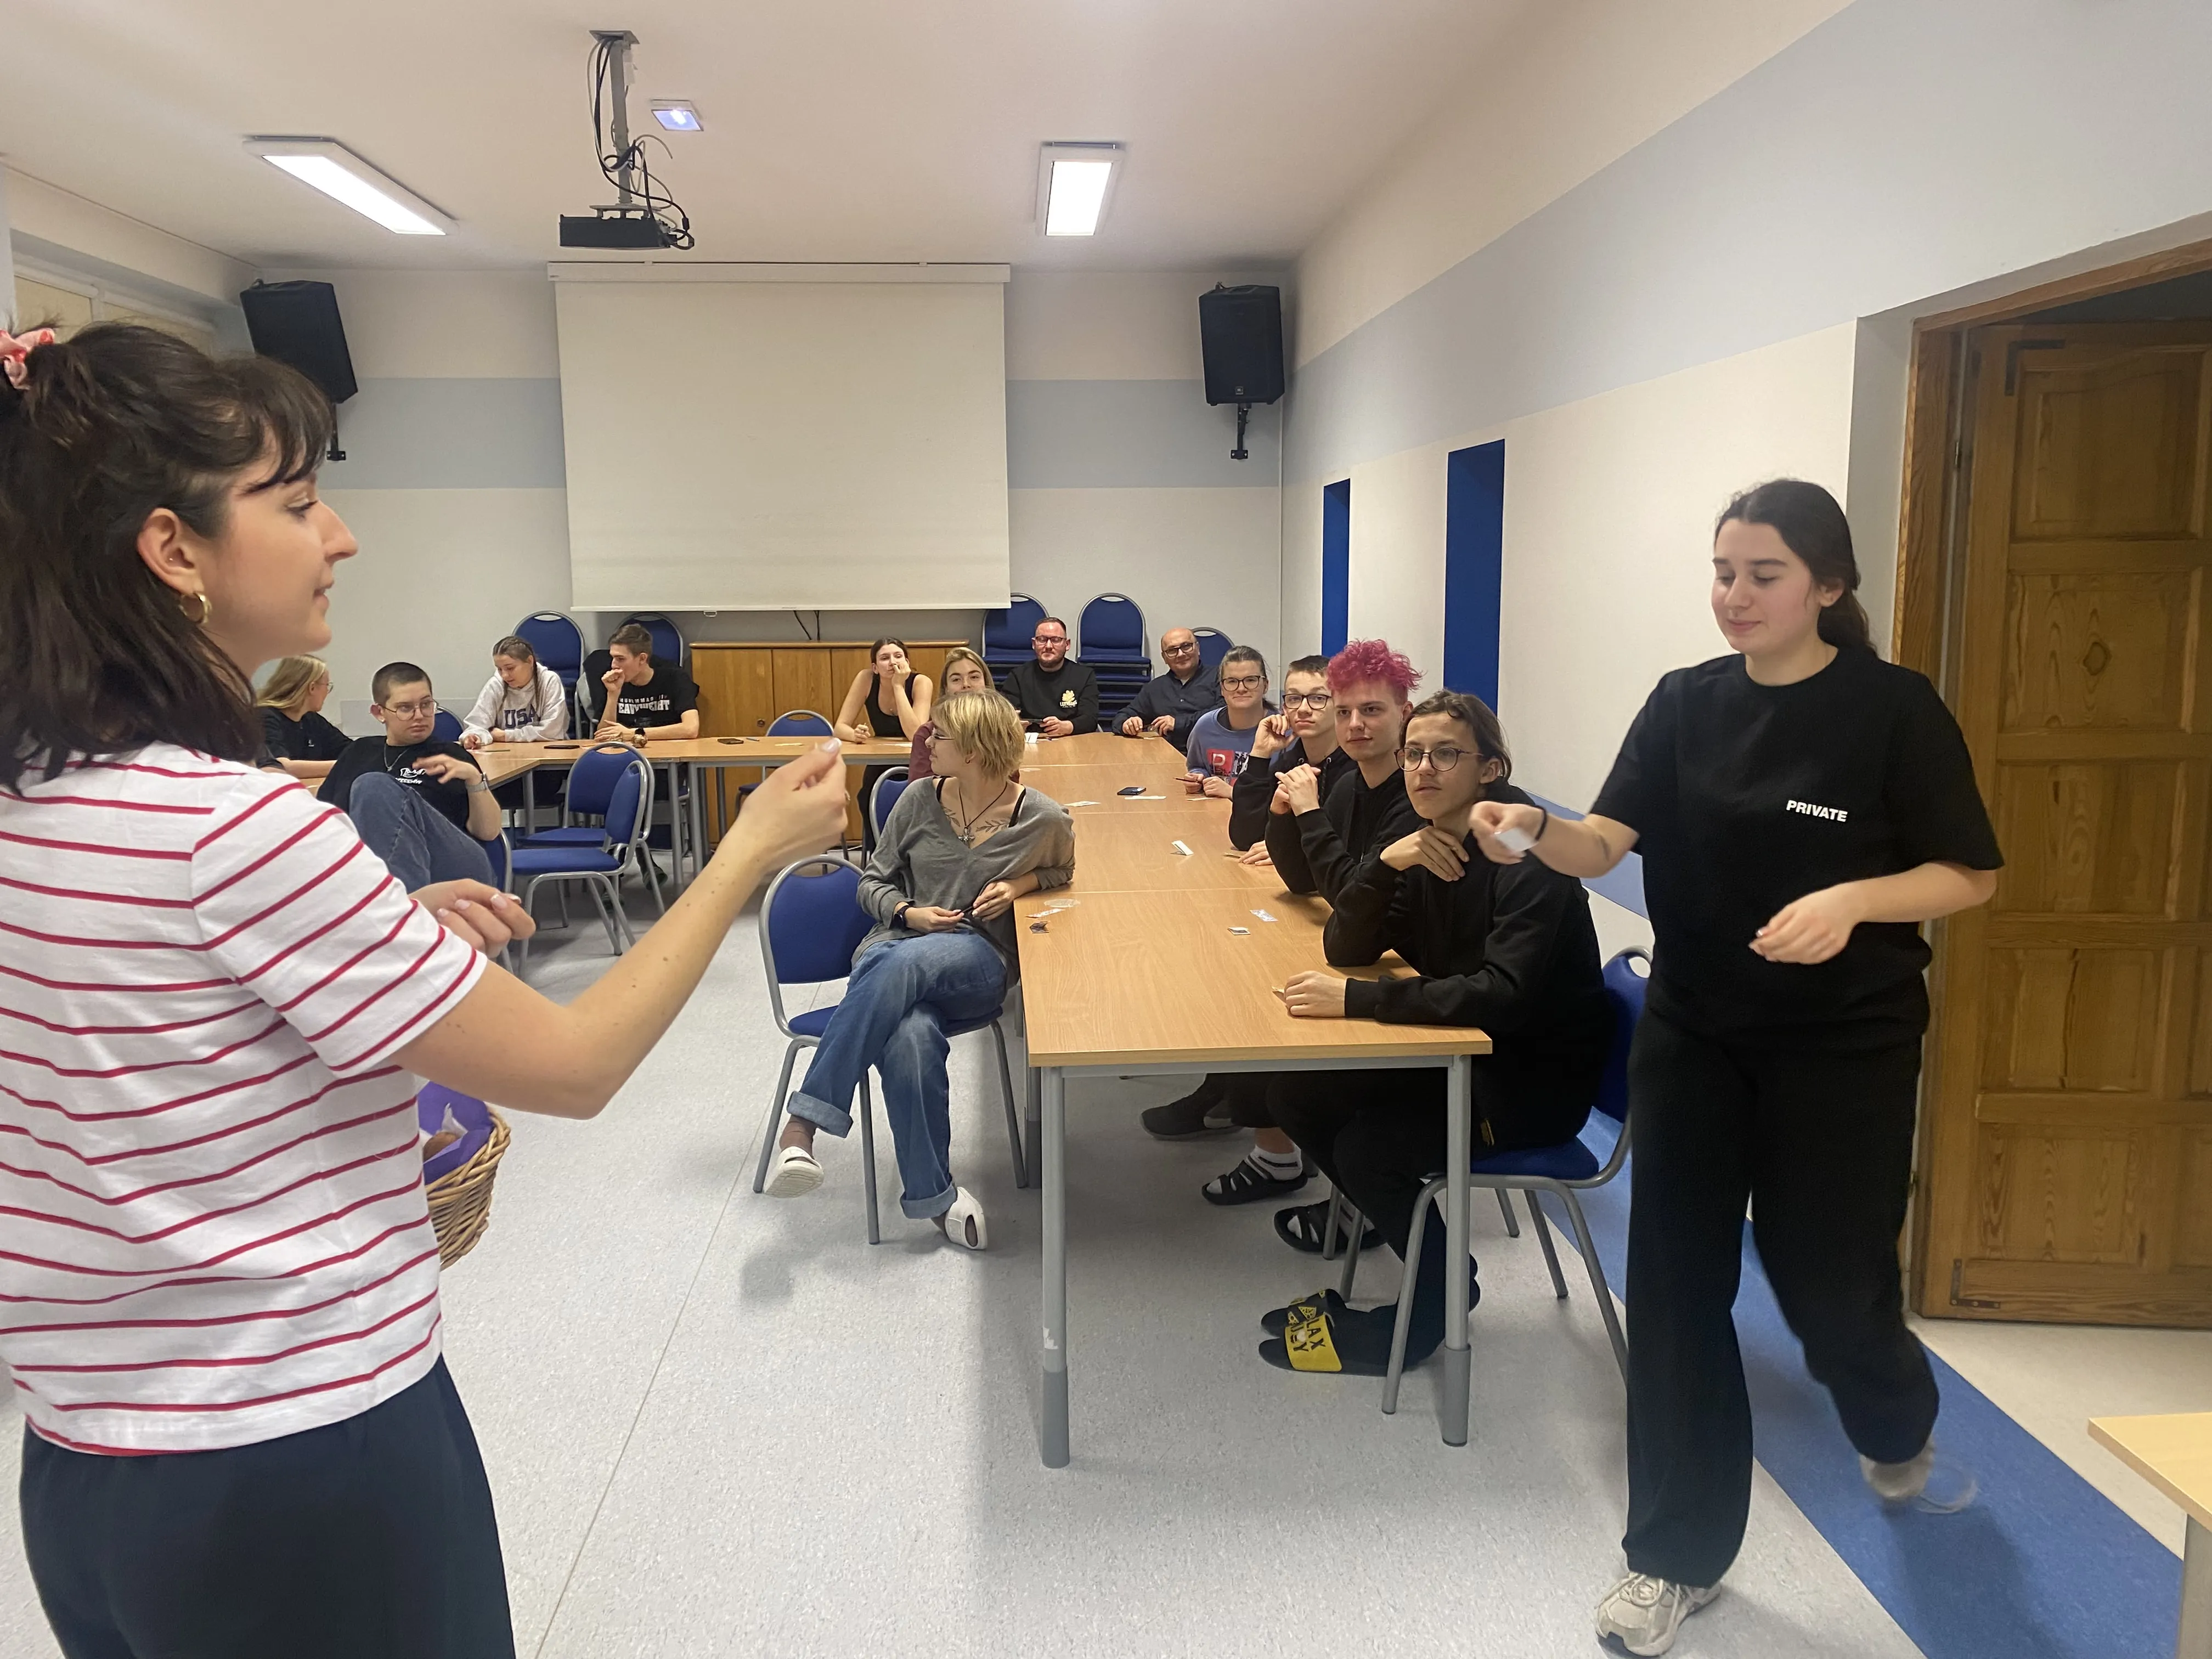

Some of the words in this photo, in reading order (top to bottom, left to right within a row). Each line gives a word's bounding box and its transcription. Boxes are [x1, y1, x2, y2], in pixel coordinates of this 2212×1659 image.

[504, 704, 541, 729] USA
[1786, 799, 1848, 822] PRIVATE
[1306, 1318, 1326, 1351] LAX
